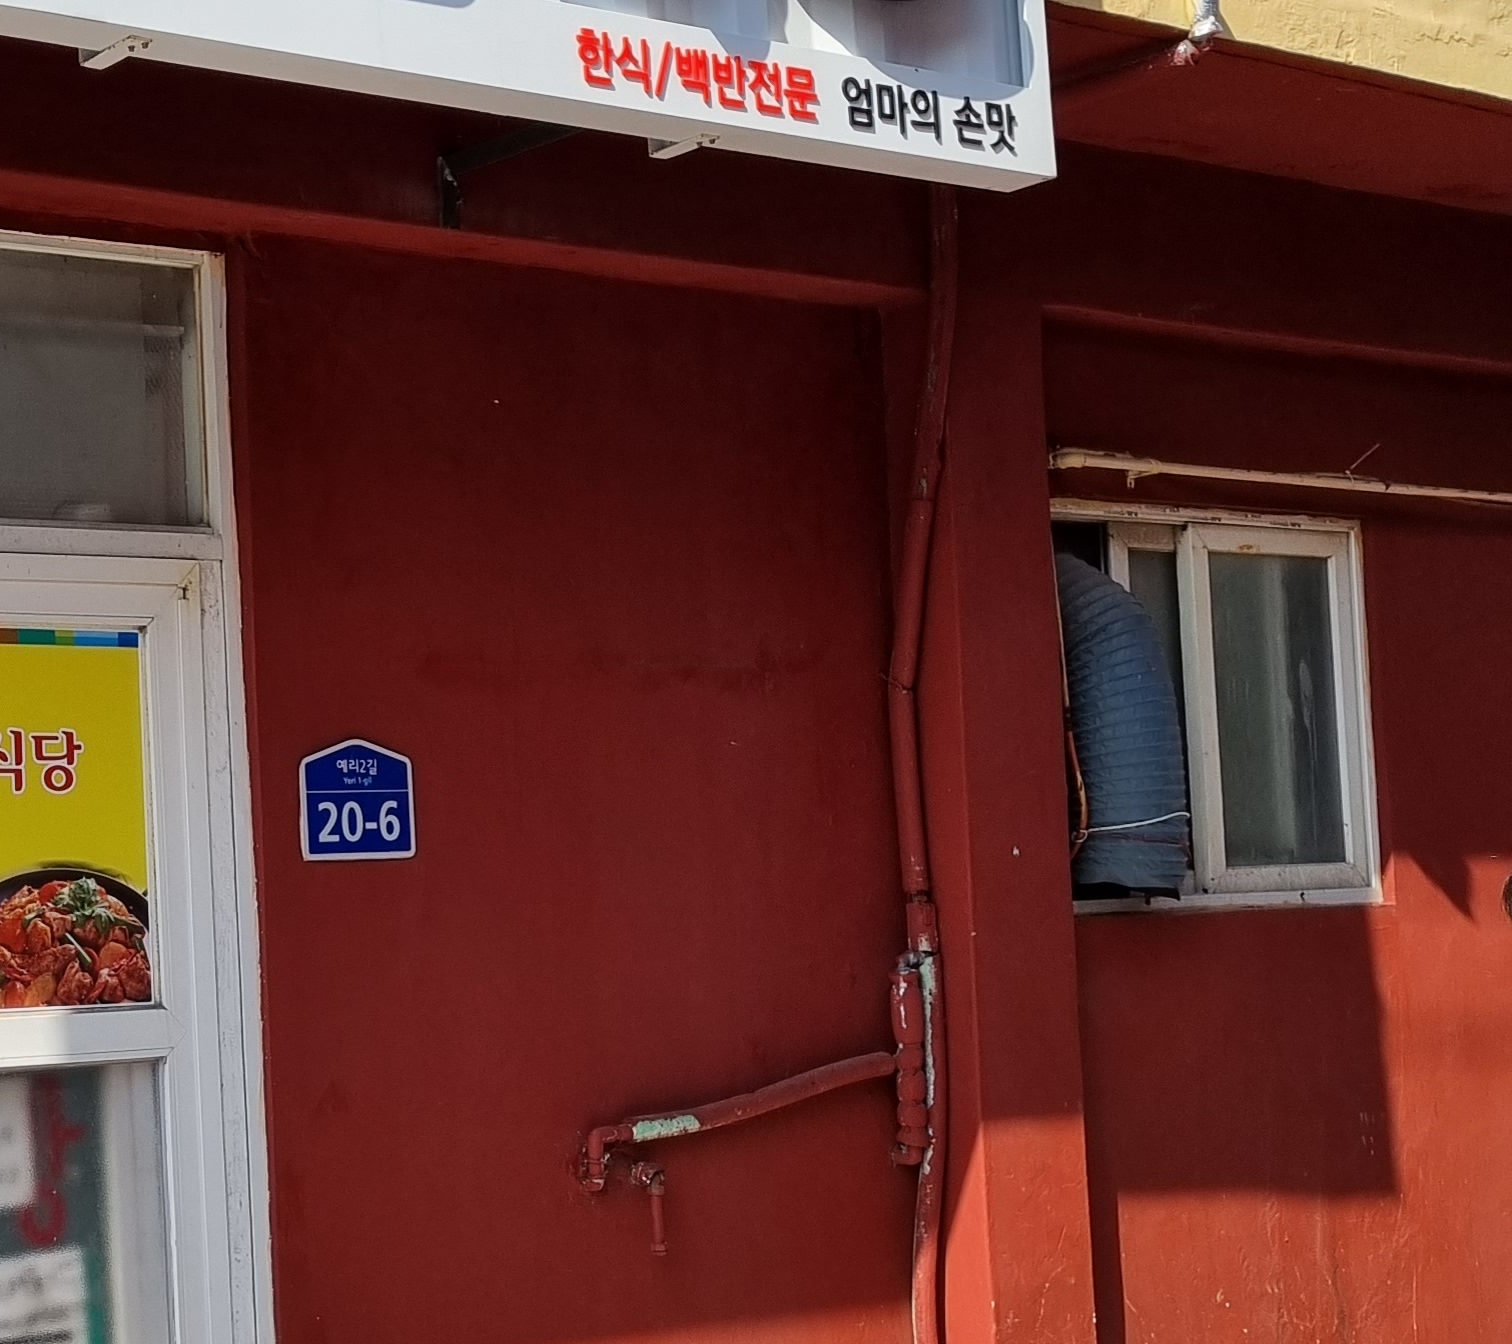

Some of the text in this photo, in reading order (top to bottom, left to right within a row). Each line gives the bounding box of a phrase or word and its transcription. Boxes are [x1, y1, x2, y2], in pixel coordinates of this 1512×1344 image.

[576, 27, 1019, 155] 한식/백반전문 엄마의 손맛
[317, 800, 401, 843] 20-6
